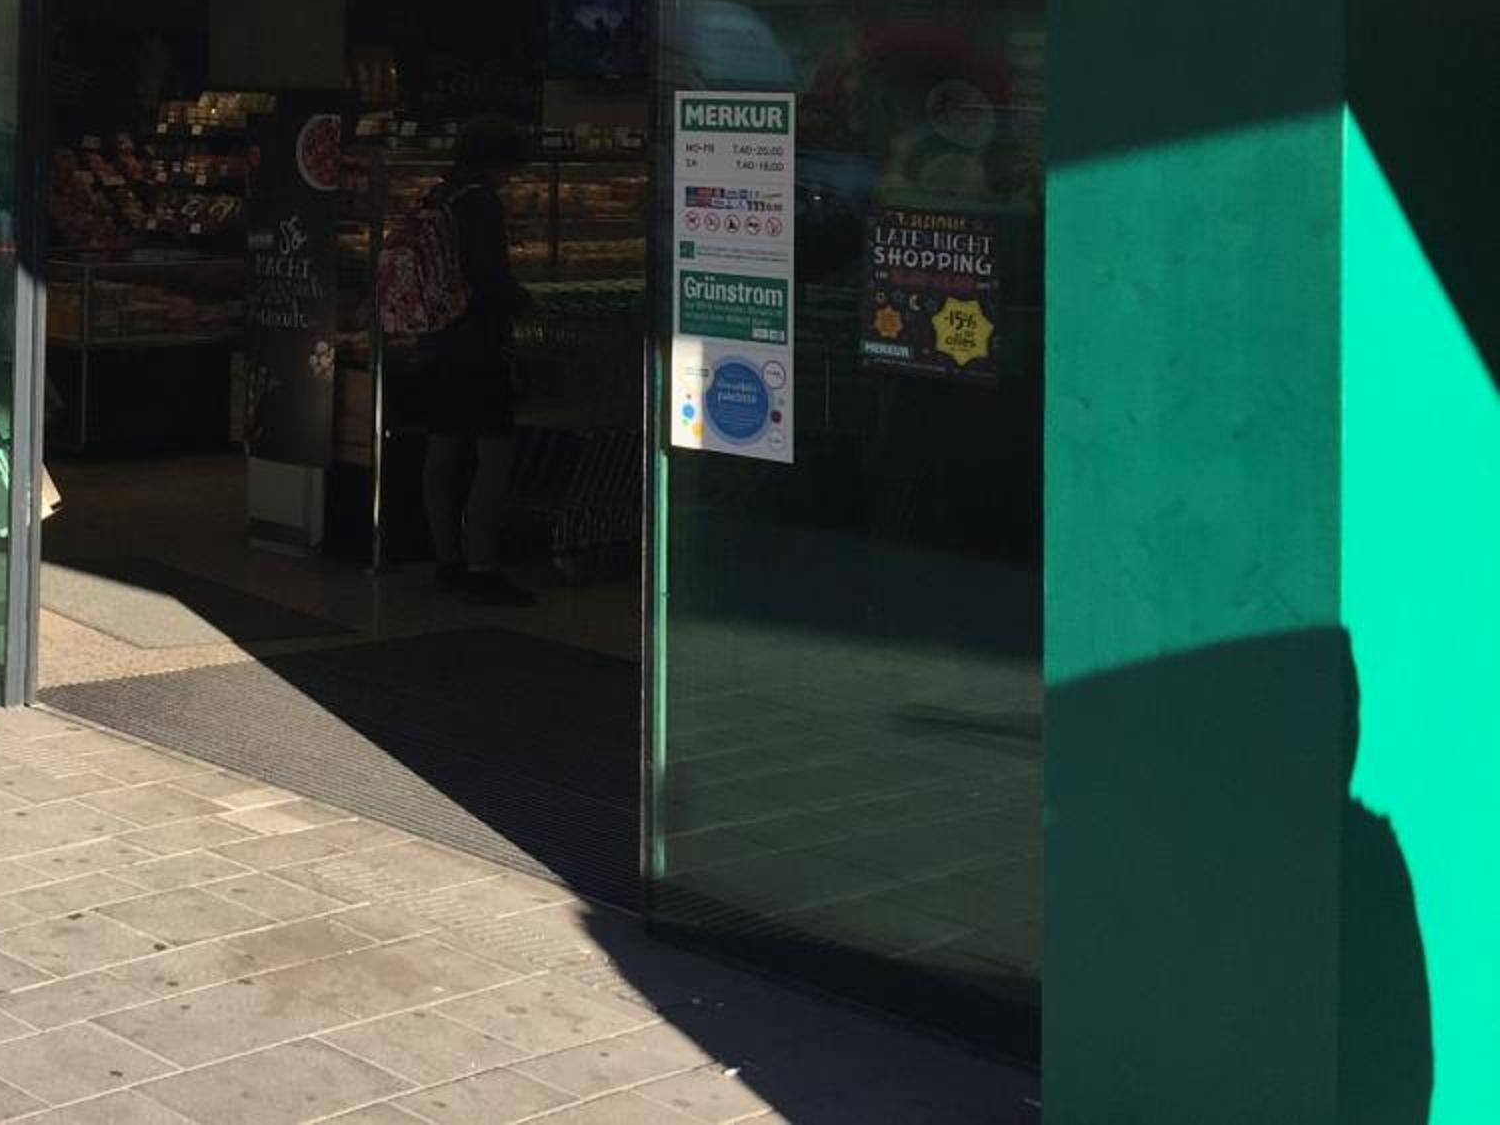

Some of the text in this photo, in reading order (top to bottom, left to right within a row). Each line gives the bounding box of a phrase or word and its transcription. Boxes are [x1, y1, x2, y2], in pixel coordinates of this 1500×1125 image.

[685, 105, 783, 128] MERKUR
[873, 246, 992, 276] SHOPPING
[684, 276, 784, 307] Grünstrom
